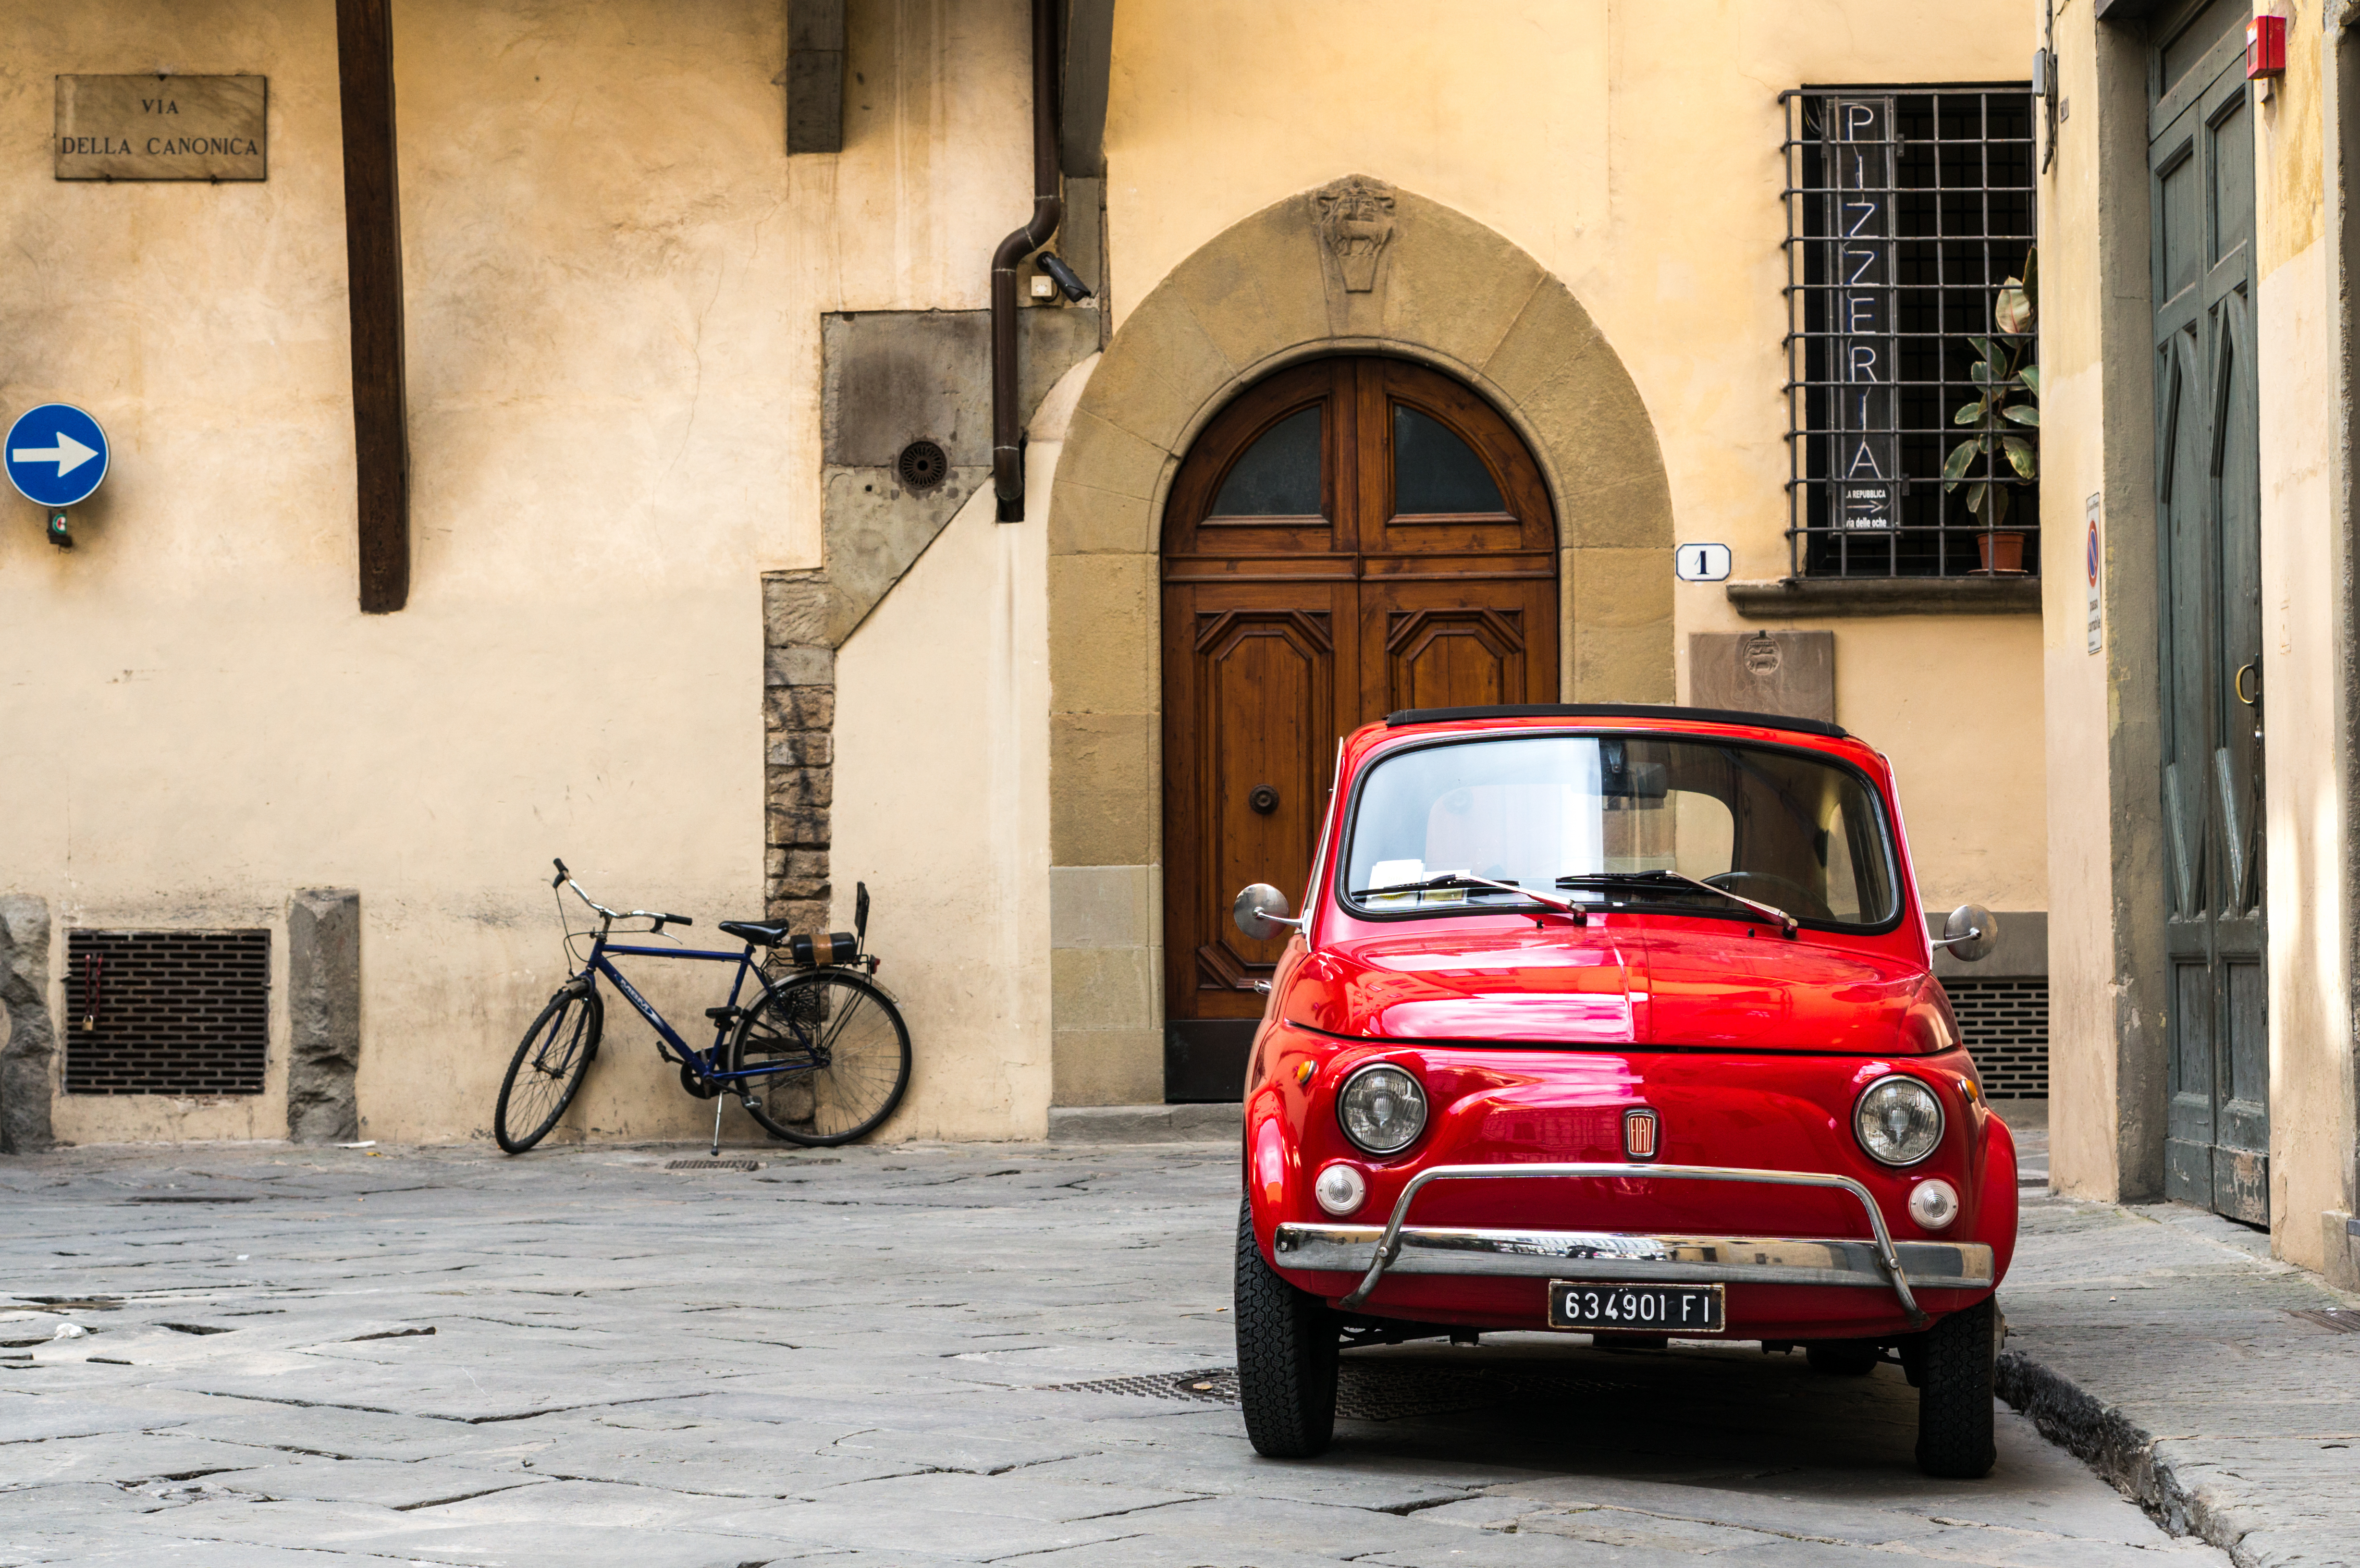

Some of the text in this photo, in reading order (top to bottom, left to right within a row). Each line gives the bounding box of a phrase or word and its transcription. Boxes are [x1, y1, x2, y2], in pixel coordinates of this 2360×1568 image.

[142, 99, 179, 114] VIA
[61, 137, 258, 155] DELLA CANONICA
[1846, 105, 1882, 479] PIZZERIA
[1853, 490, 1886, 498] REPUBBLICA
[1856, 517, 1870, 527] delle
[1872, 517, 1887, 527] oche
[1694, 550, 1710, 575] 1
[620, 979, 649, 1011] MBM
[1630, 1117, 1651, 1152] FIAT
[1565, 1292, 1665, 1321] 634901
